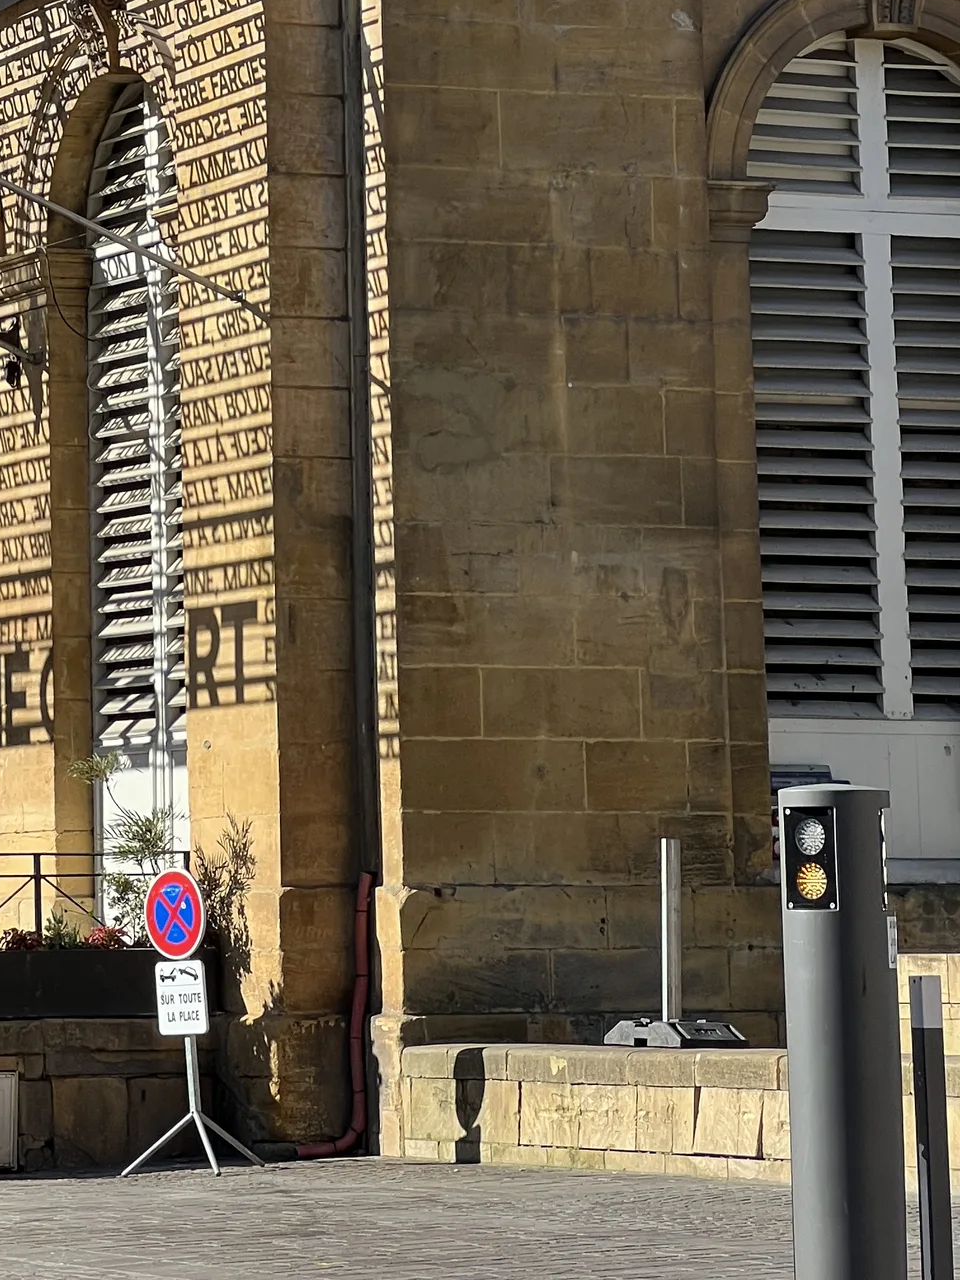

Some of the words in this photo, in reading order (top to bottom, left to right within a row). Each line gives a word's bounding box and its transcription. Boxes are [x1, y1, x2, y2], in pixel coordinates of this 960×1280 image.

[160, 992, 175, 1005] SUR
[178, 991, 202, 1004] TOUTE
[167, 1010, 176, 1023] LA
[179, 1009, 200, 1022] PLACE
